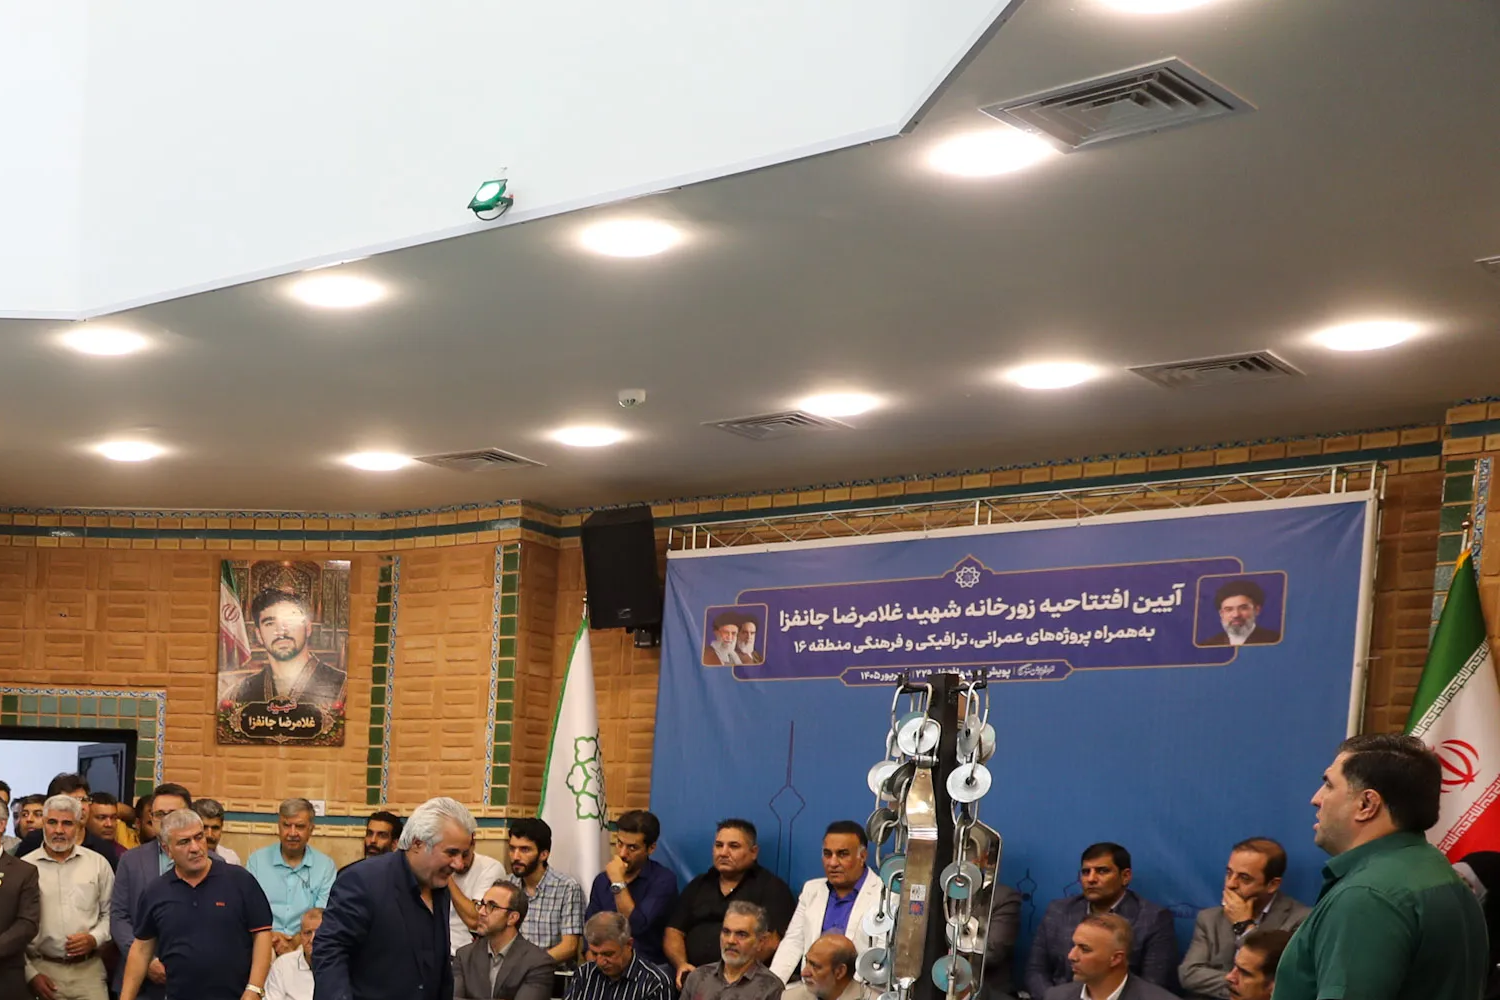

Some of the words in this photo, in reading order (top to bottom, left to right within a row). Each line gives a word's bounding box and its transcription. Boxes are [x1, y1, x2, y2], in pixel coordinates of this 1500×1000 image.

[1039, 587, 1130, 618] افتتاحیه
[1132, 583, 1185, 613] آیین
[833, 602, 904, 628] غلامرضا
[906, 600, 962, 625] شهید
[965, 597, 1036, 620] زورخانه
[779, 608, 830, 632] جانفزا
[794, 640, 808, 653] ۱۶
[808, 637, 851, 652] منطقه
[852, 633, 903, 654] فرهنگی
[905, 639, 914, 650] و
[915, 631, 968, 650] ترافیکی
[970, 630, 1024, 648] عمرانی،
[248, 715, 277, 730] جانفزا
[278, 716, 316, 731] غلامرضا
